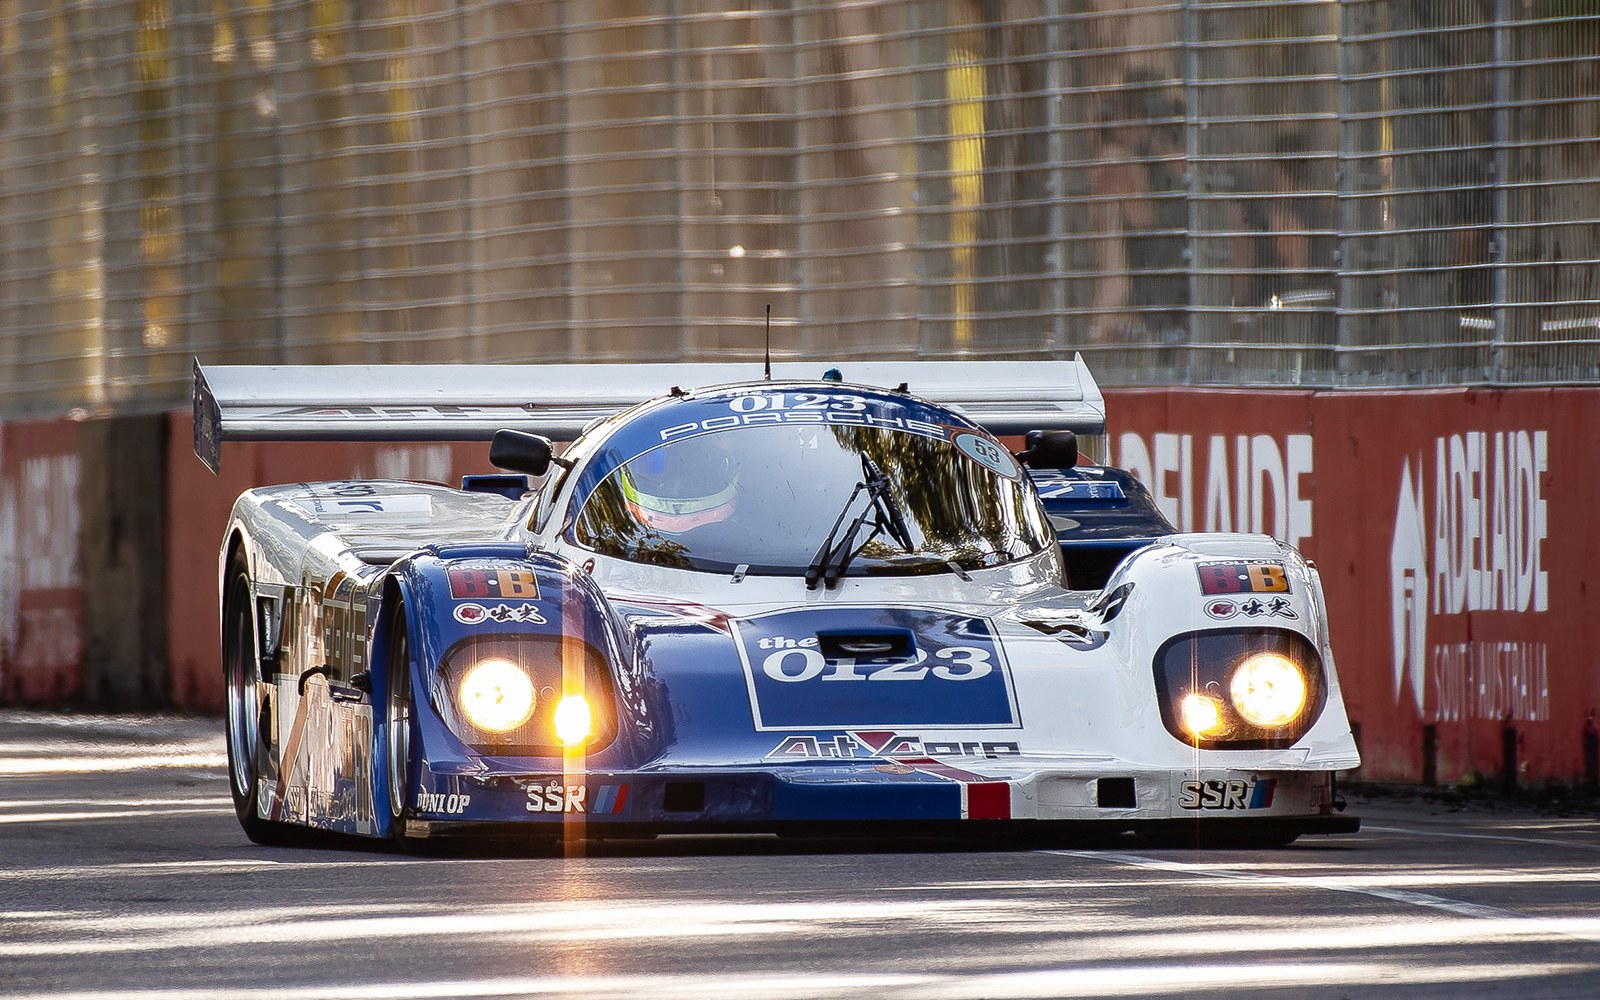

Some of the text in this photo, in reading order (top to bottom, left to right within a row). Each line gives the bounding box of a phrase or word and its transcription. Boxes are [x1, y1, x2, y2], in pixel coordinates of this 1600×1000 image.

[729, 392, 866, 413] 0123
[660, 411, 945, 440] PORSCHE
[974, 438, 1001, 464] 53
[1434, 430, 1548, 615] ADELAIDE
[757, 637, 818, 649] the
[763, 647, 992, 682] 0123
[526, 785, 587, 813] SSR
[1178, 779, 1247, 810] SSR
